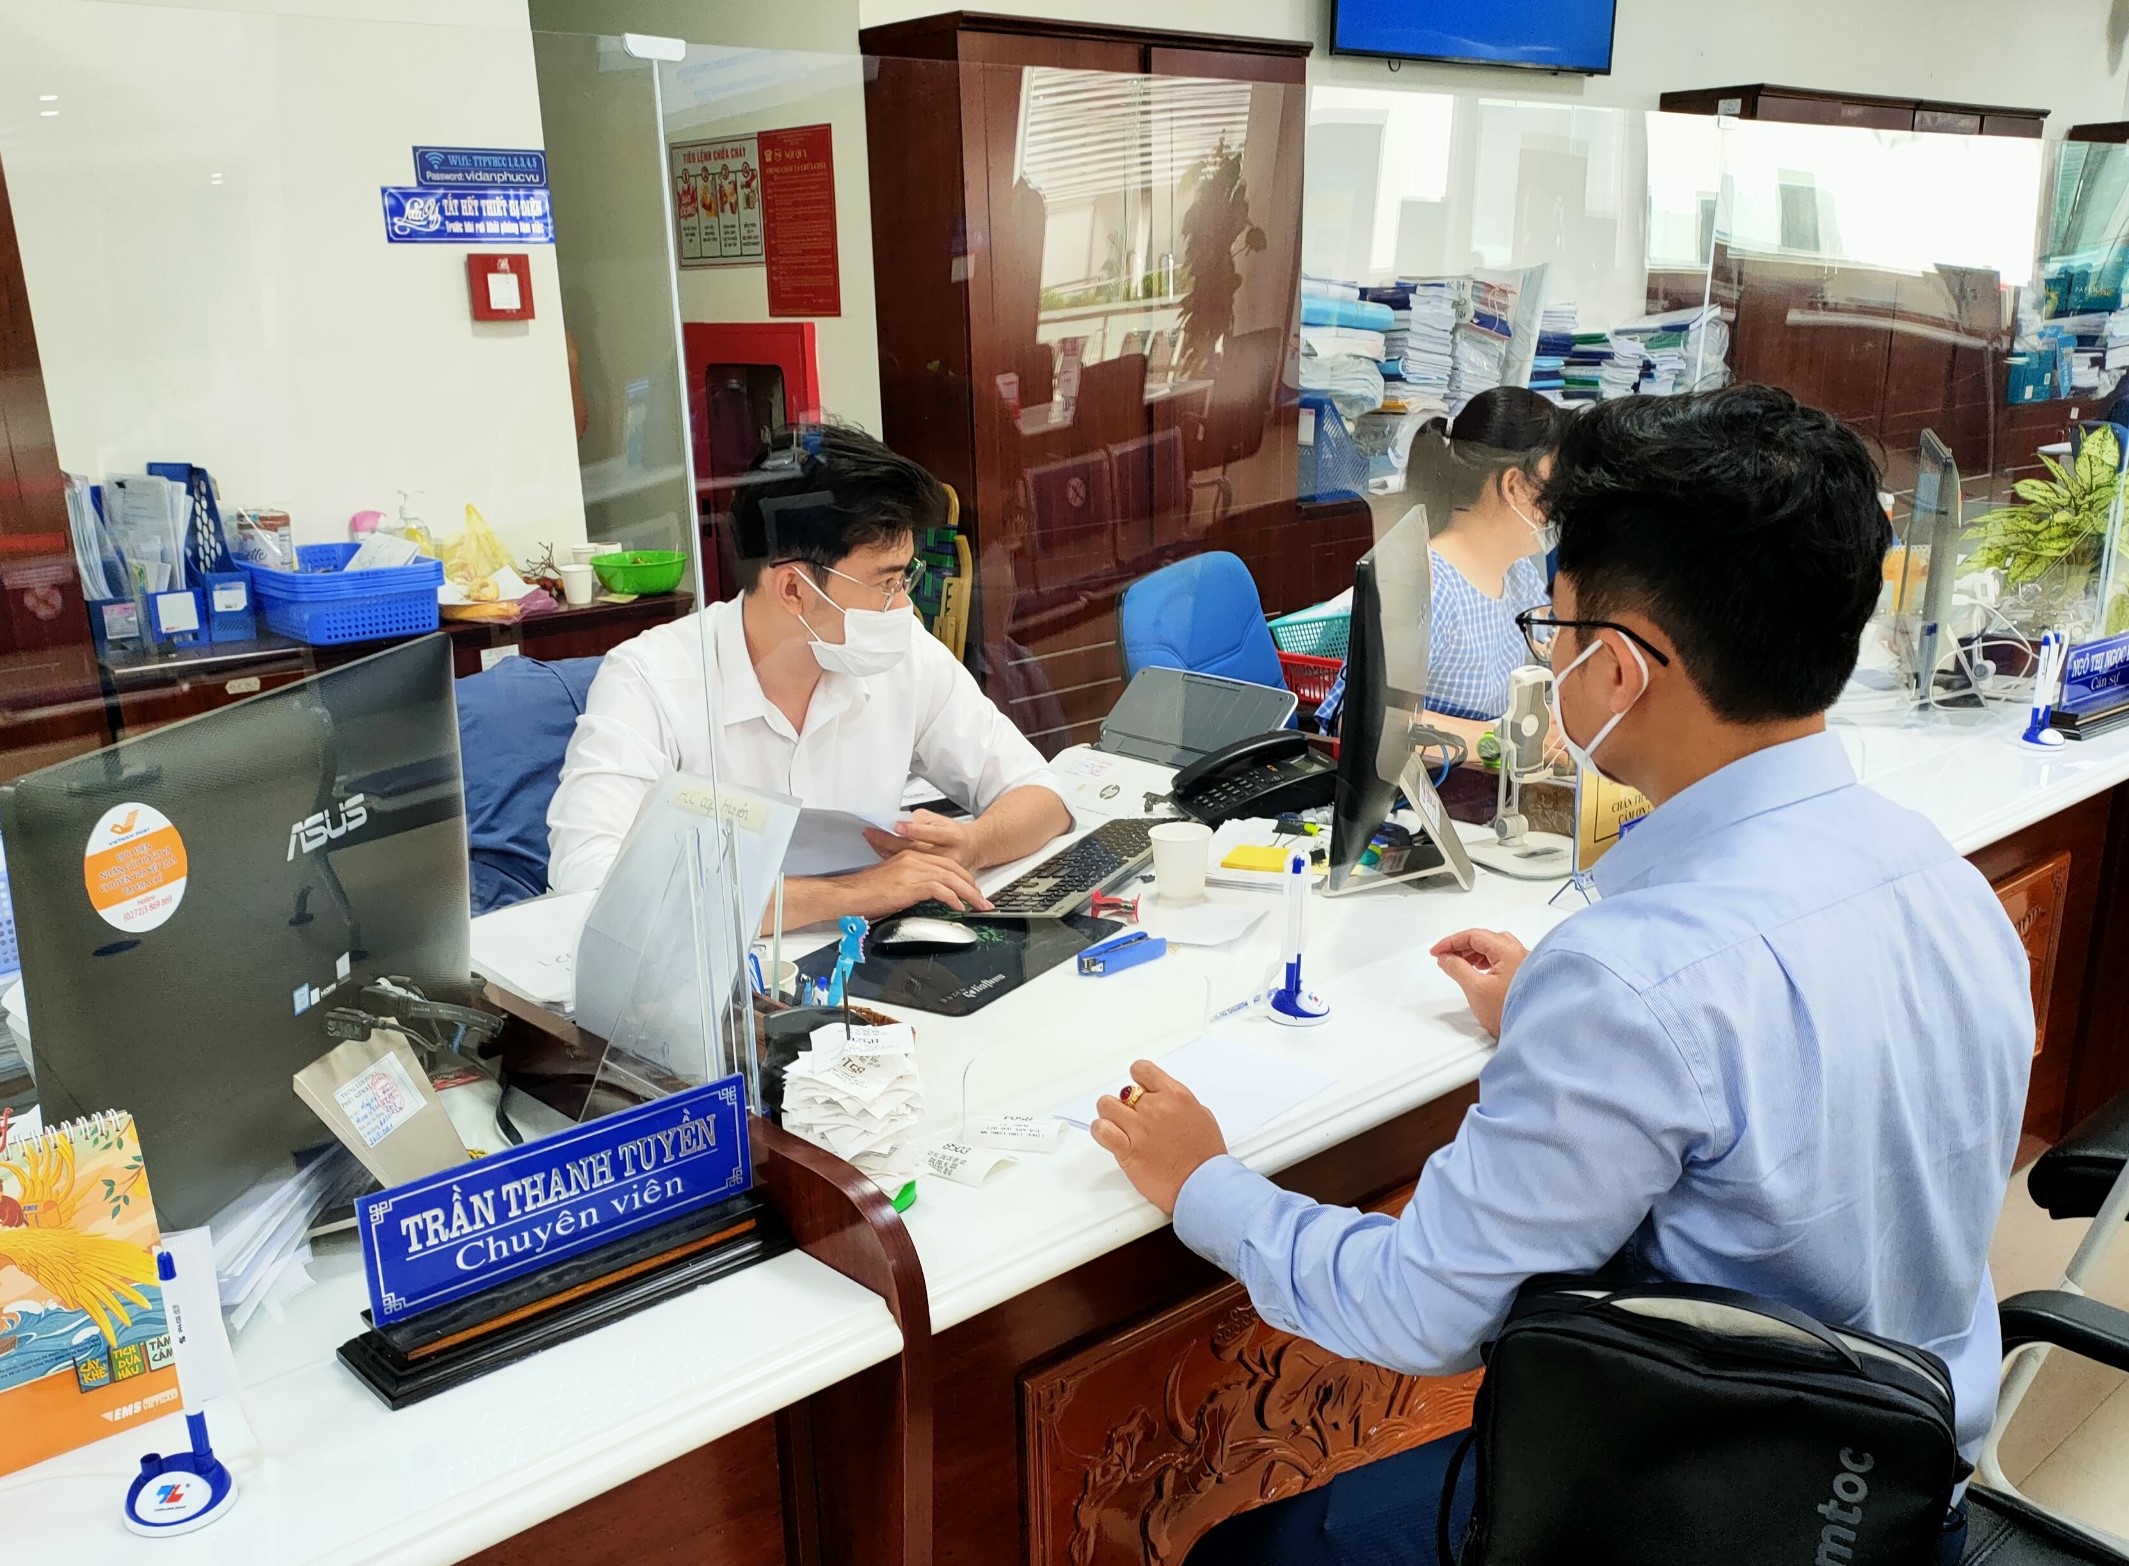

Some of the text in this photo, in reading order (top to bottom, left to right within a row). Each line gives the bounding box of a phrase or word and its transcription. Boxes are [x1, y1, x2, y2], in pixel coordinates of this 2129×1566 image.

[427, 170, 539, 183] Password: vidanphucvu
[442, 193, 459, 216] TẮT
[460, 195, 479, 216] HẾT
[2071, 652, 2090, 678] NGÔ
[2090, 652, 2105, 674] THỊ
[2091, 676, 2107, 690] Cán
[287, 793, 367, 861] ASUS
[401, 1109, 717, 1253] TRẦN THANH TUYỀN
[455, 1173, 684, 1271] Chuyên viên
[114, 1400, 141, 1421] EMS
